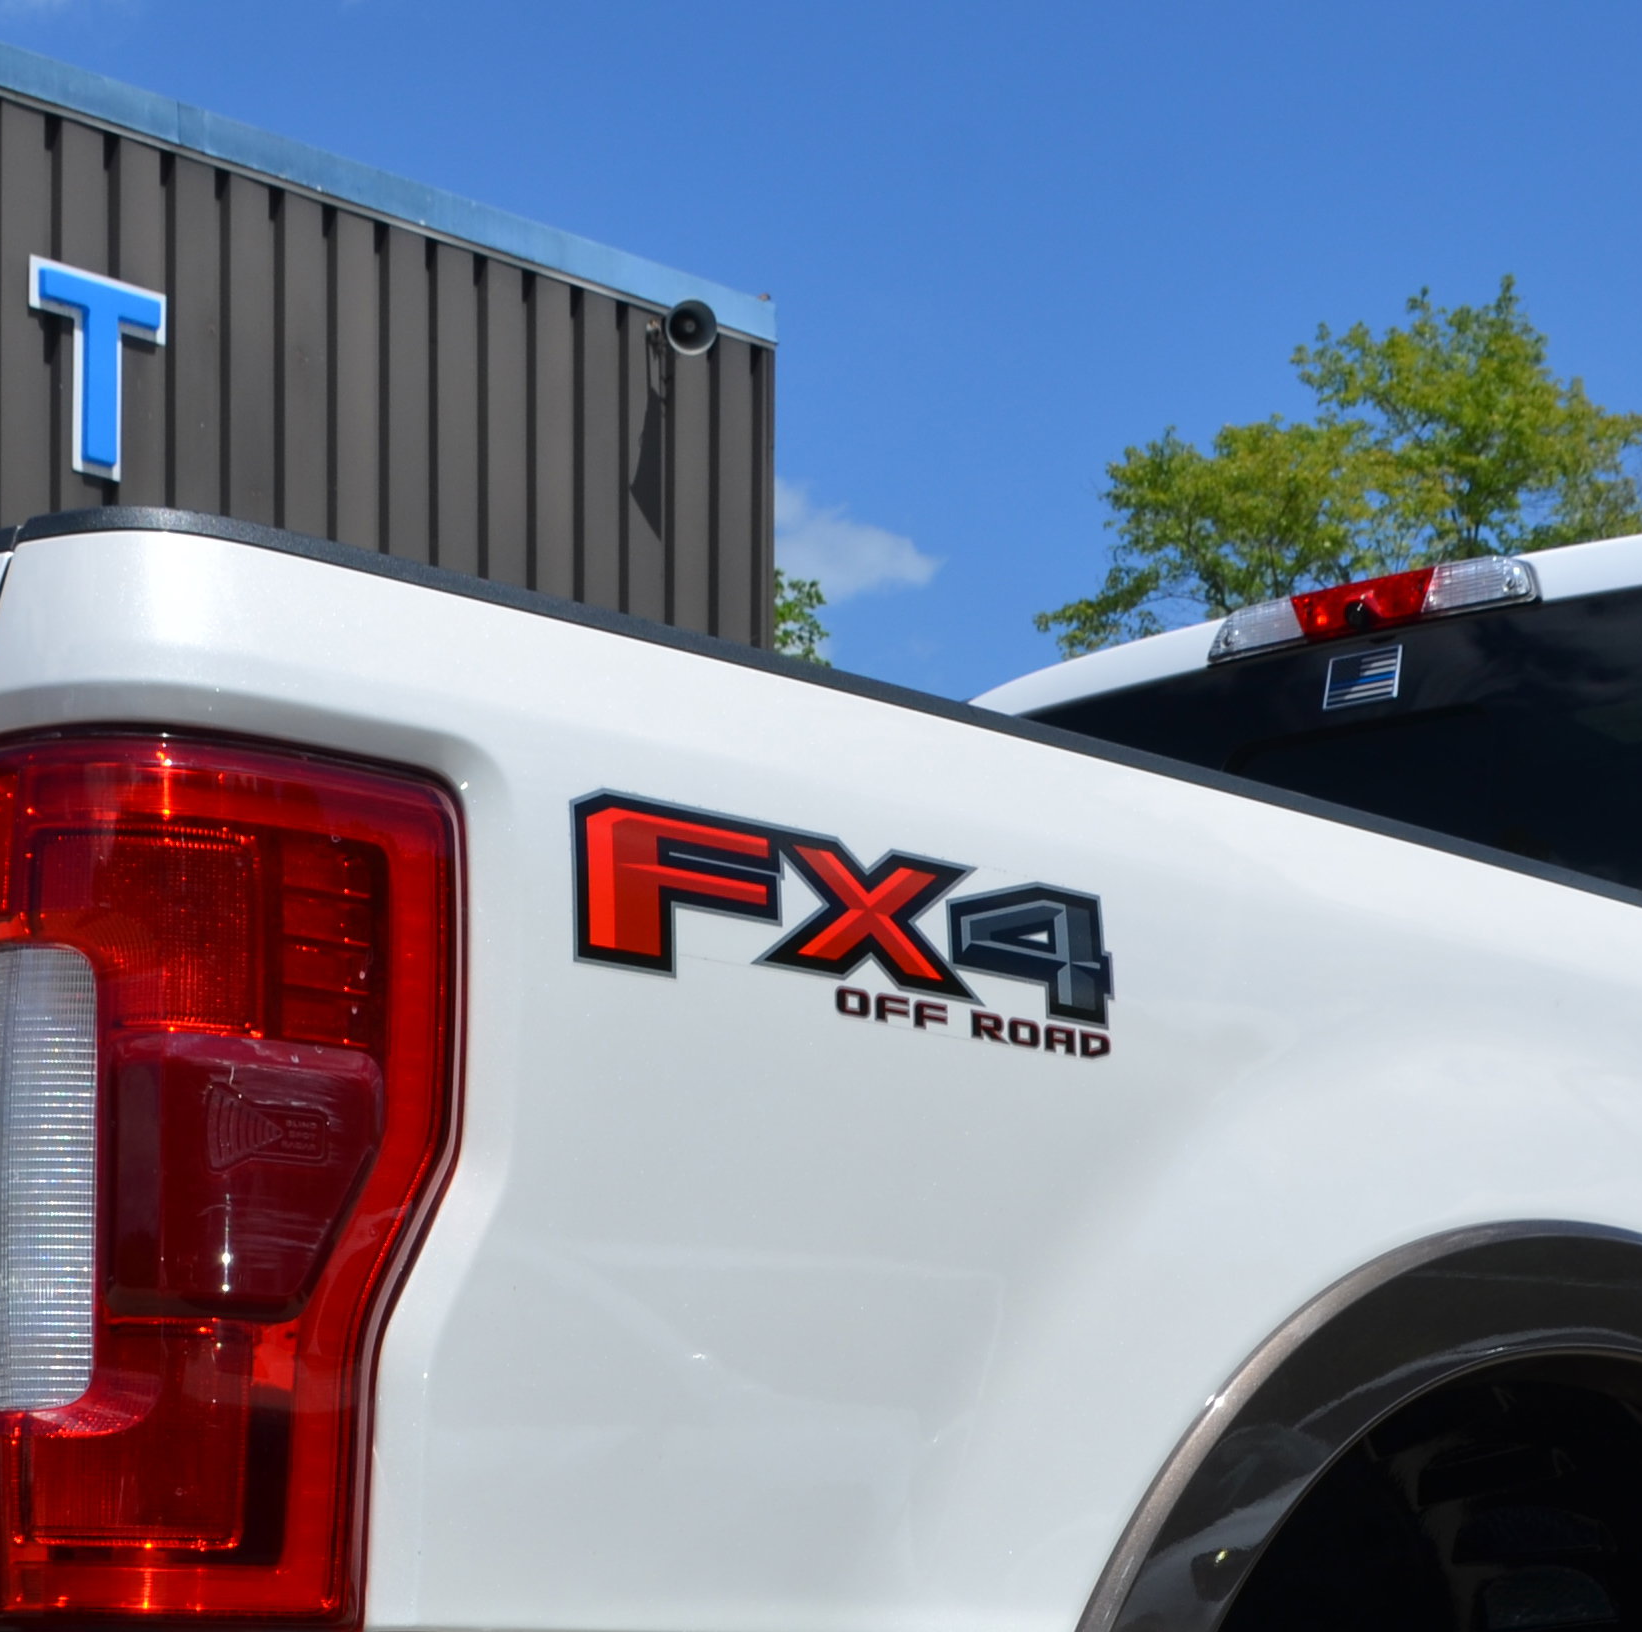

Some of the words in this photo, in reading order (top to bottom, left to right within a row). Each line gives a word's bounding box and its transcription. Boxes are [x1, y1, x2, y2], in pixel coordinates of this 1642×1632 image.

[570, 788, 1114, 1028] FX4
[835, 986, 949, 1030] OFF
[970, 1008, 1112, 1060] ROAD
